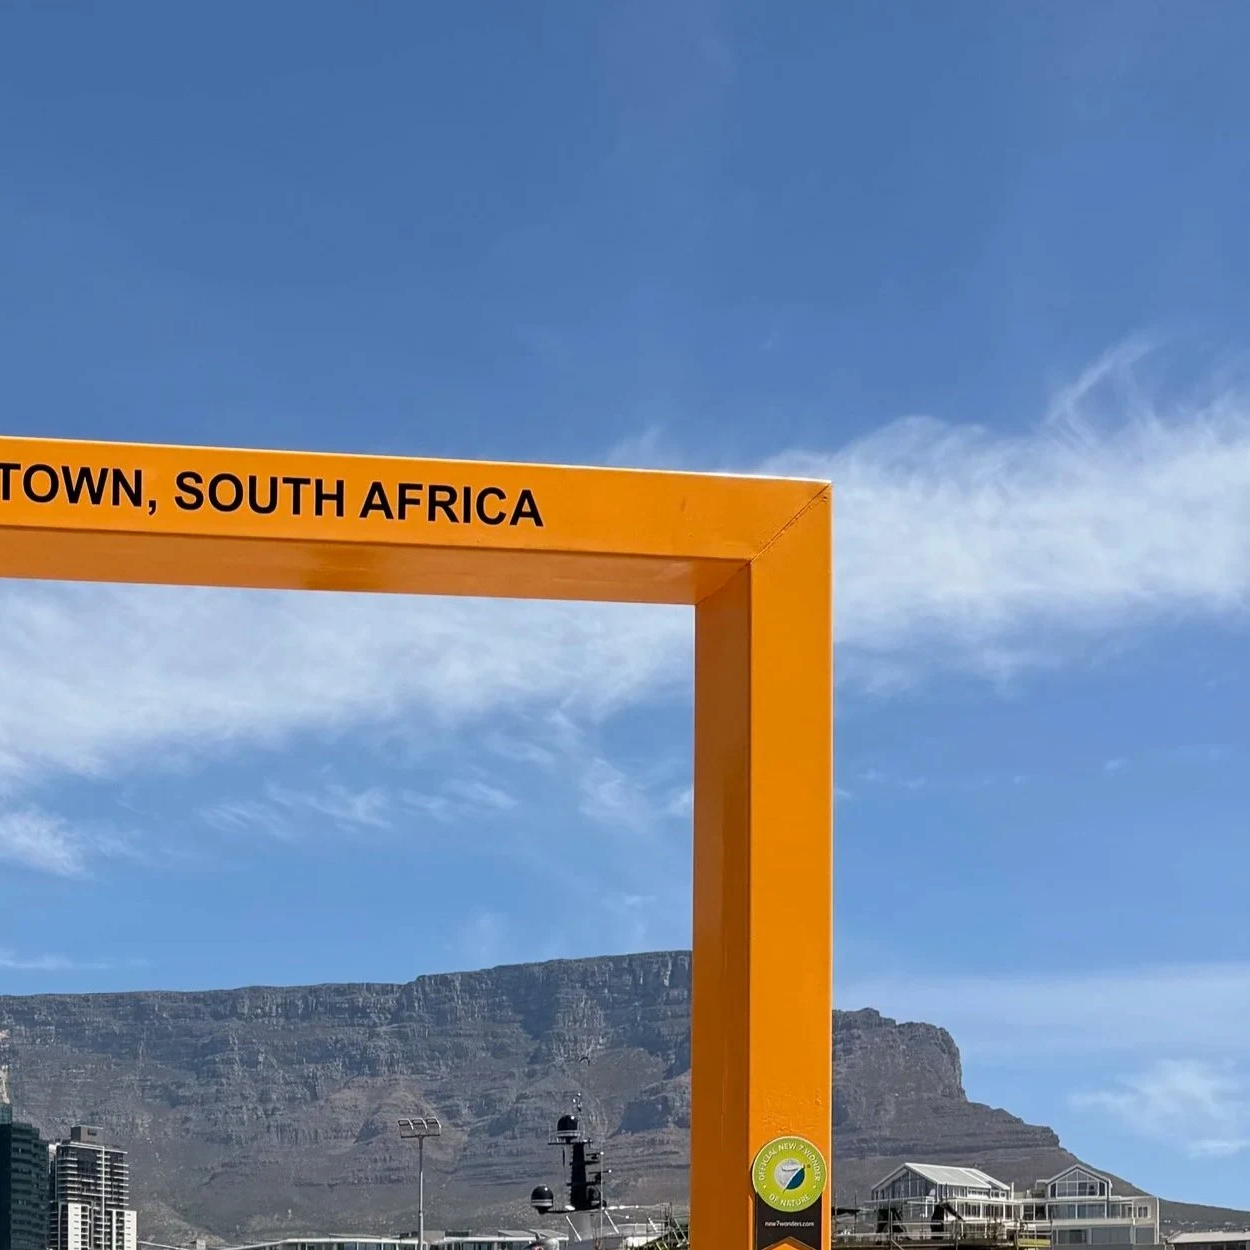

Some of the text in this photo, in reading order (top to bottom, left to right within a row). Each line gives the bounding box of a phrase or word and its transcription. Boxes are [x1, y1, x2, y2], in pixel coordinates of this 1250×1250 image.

[175, 472, 343, 516] SOUTH
[360, 482, 543, 526] AFRICA
[777, 1142, 797, 1152] NEW
